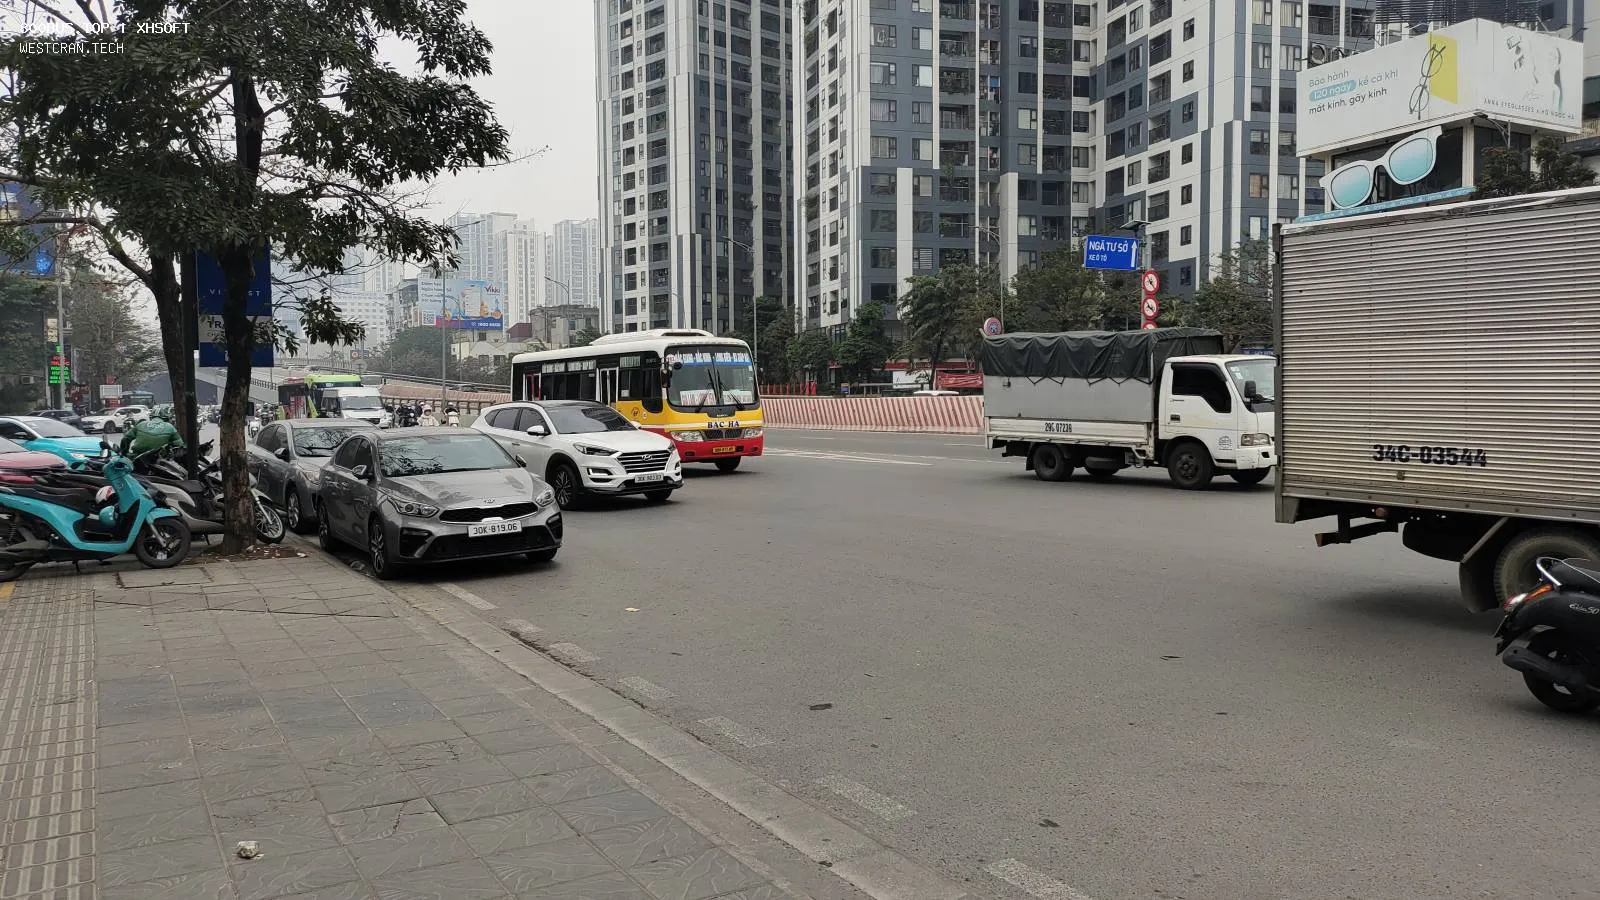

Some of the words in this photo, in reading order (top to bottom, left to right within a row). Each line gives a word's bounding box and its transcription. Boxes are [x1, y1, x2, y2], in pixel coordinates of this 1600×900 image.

[1385, 68, 1398, 80] khi
[1368, 87, 1387, 99] kính
[1088, 240, 1106, 251] NGÃ
[1106, 241, 1118, 252] TƯ
[1117, 240, 1129, 253] SỞ
[484, 283, 501, 294] Vikki
[1372, 444, 1487, 467] 34C-03544
